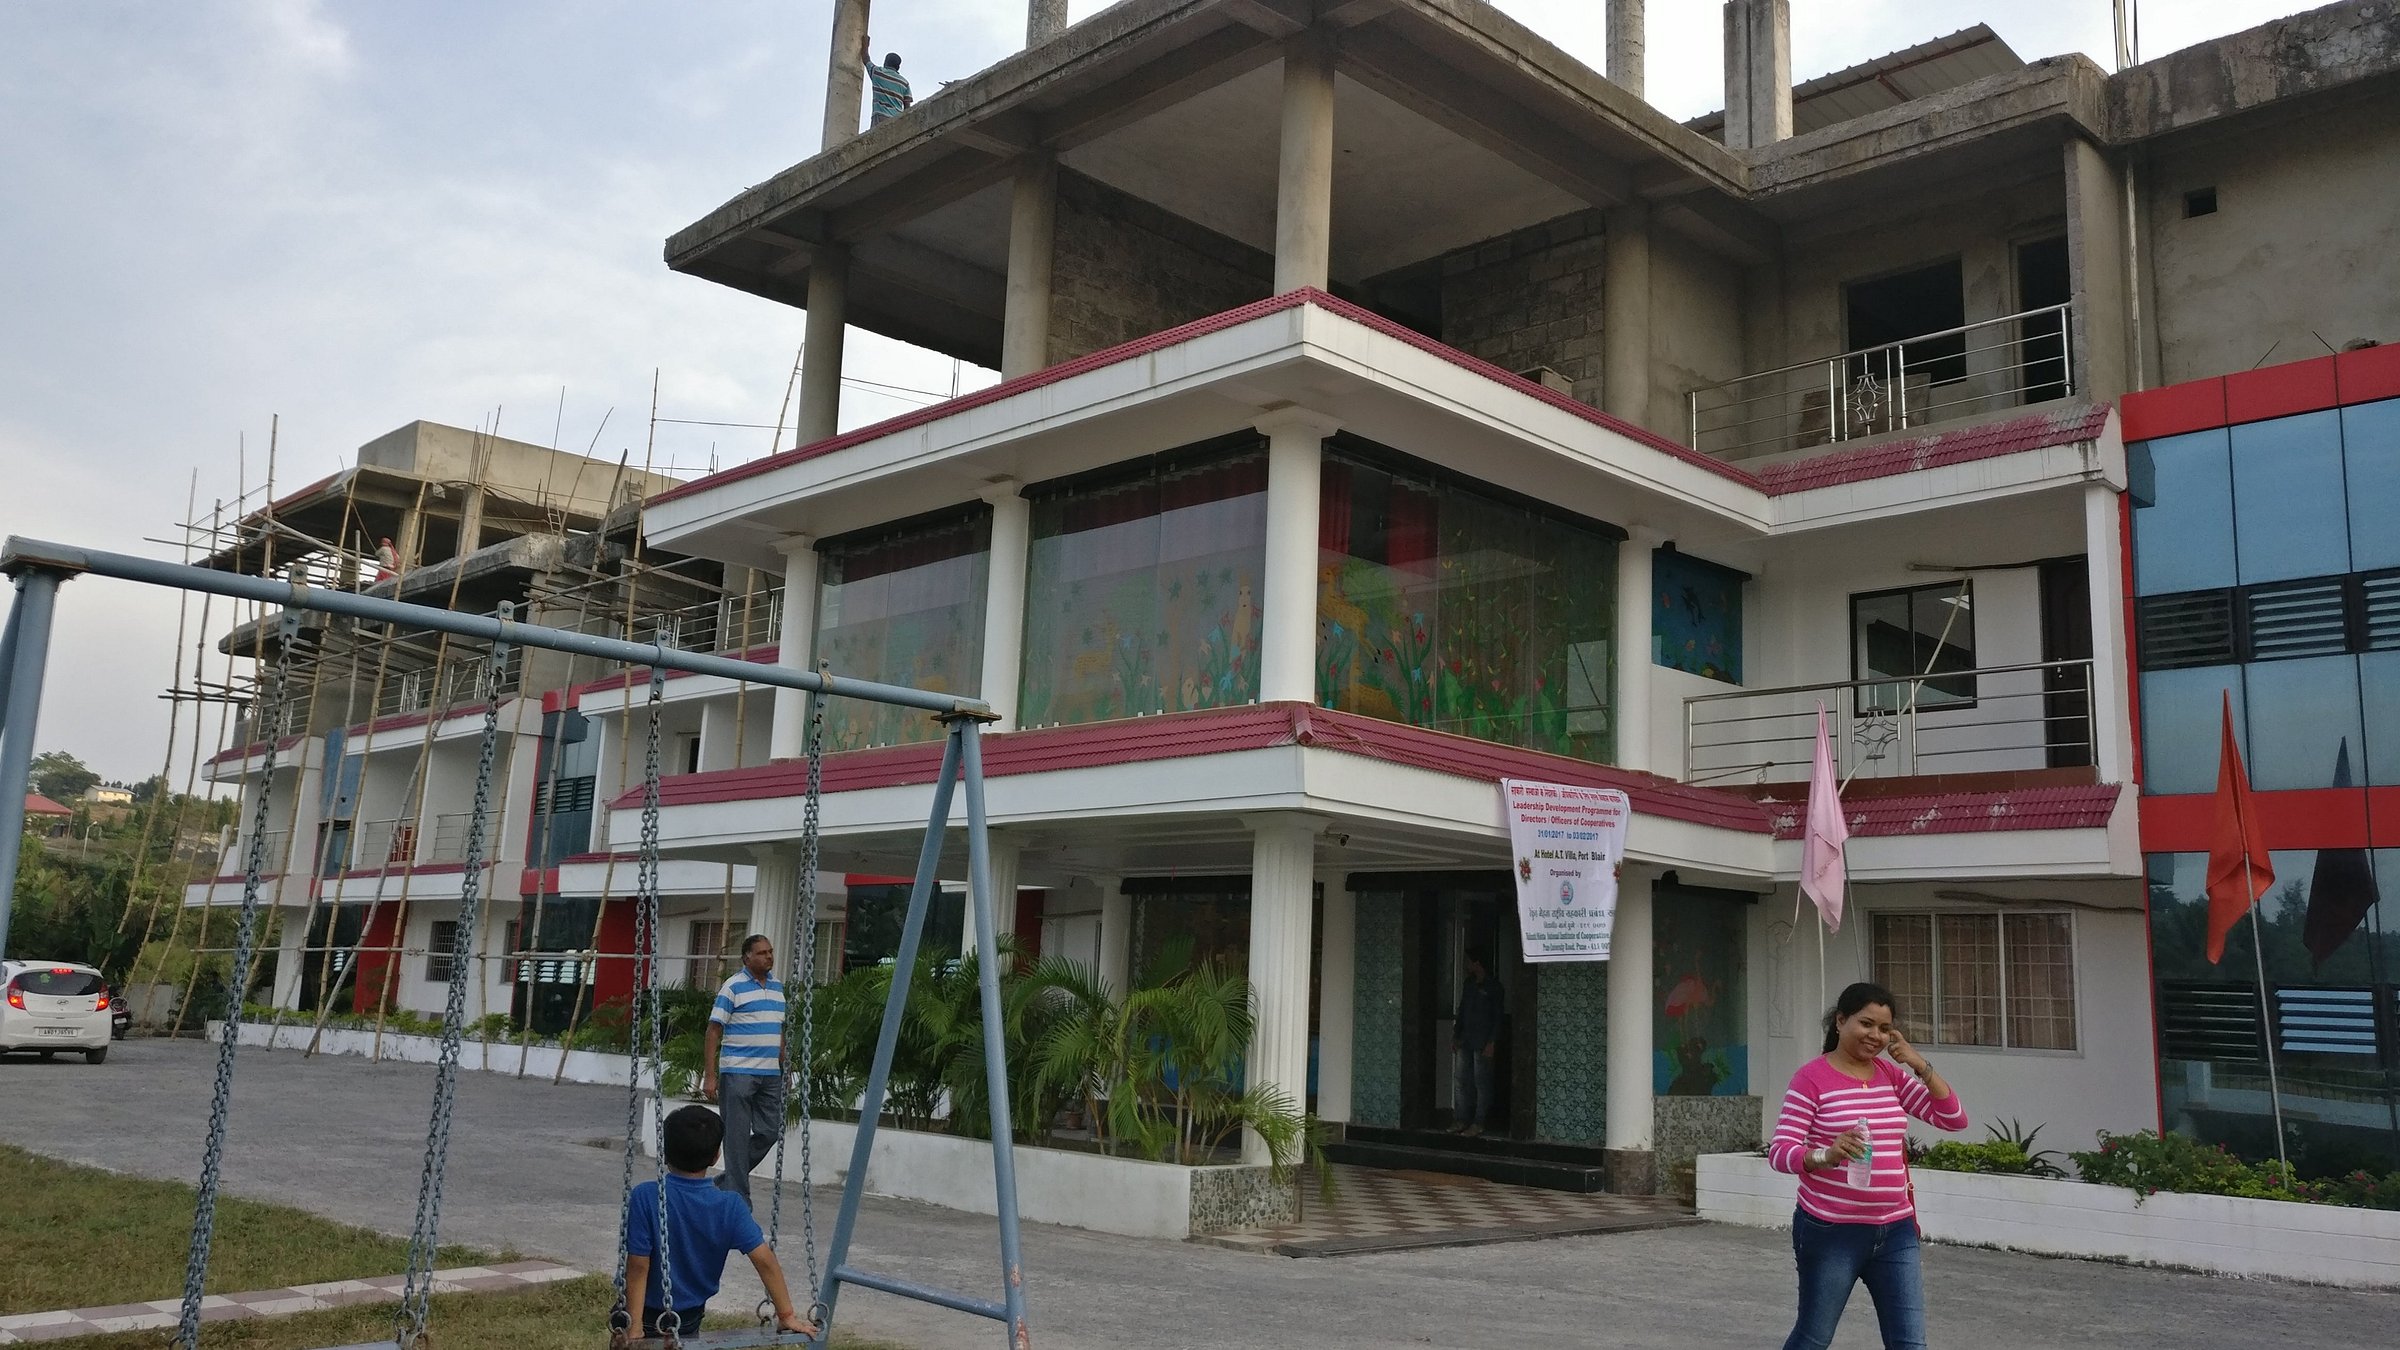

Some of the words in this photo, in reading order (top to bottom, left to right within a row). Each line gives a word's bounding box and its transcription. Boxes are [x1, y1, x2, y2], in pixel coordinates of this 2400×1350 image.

[1513, 800, 1544, 812] Leadership
[1545, 803, 1581, 814] Development
[1582, 805, 1612, 817] Programme
[1613, 808, 1621, 816] for
[1521, 814, 1547, 824] Directors
[1551, 815, 1573, 825] Officers
[1573, 817, 1579, 825] of
[1580, 818, 1616, 828] Cooperatives
[1535, 849, 1540, 858] At
[1541, 850, 1554, 859] Hotel
[1578, 851, 1589, 861] Port
[1591, 852, 1606, 861] Blair
[1550, 869, 1574, 878] Organised
[1575, 869, 1581, 878] by
